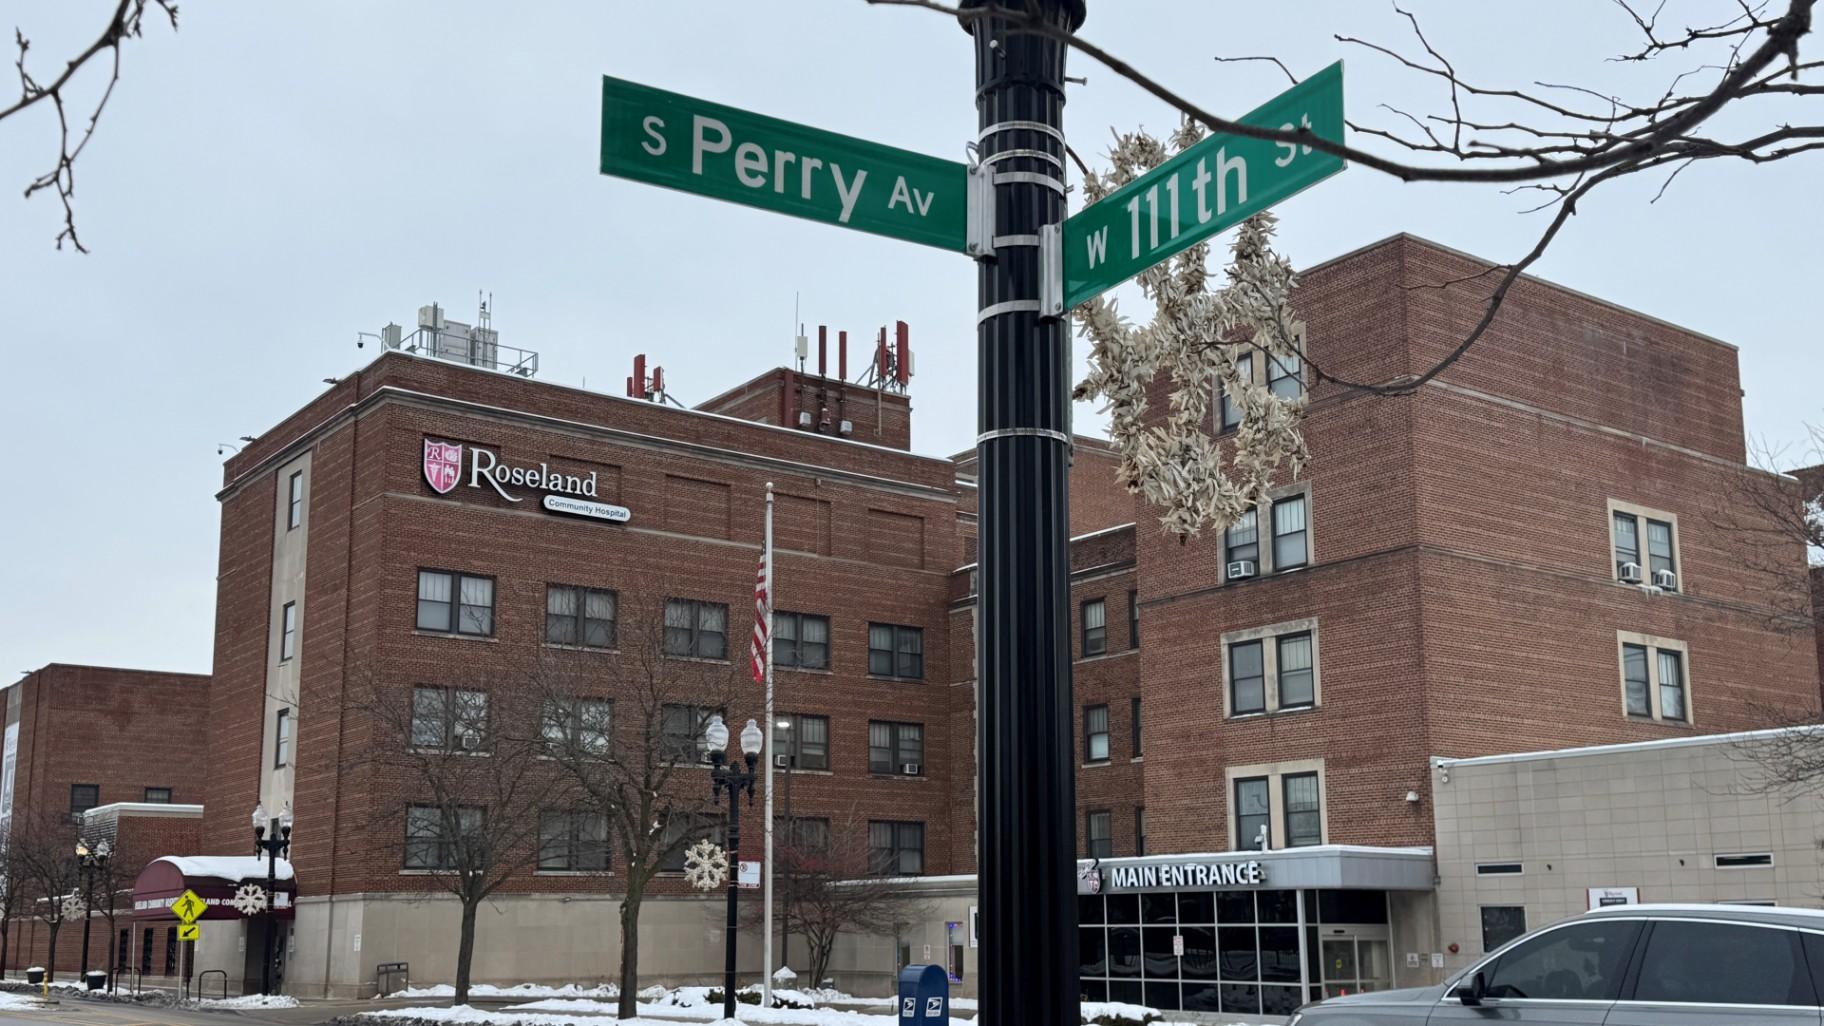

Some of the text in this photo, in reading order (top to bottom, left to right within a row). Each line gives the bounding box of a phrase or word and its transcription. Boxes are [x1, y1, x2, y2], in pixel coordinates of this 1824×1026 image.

[641, 114, 934, 223] S Perry Av
[1086, 225, 1108, 270] W
[1127, 146, 1248, 259] 111th
[468, 447, 598, 502] Roseland
[548, 498, 627, 519] Community Hospital
[1112, 862, 1259, 887] MAIN ENTRANCE
